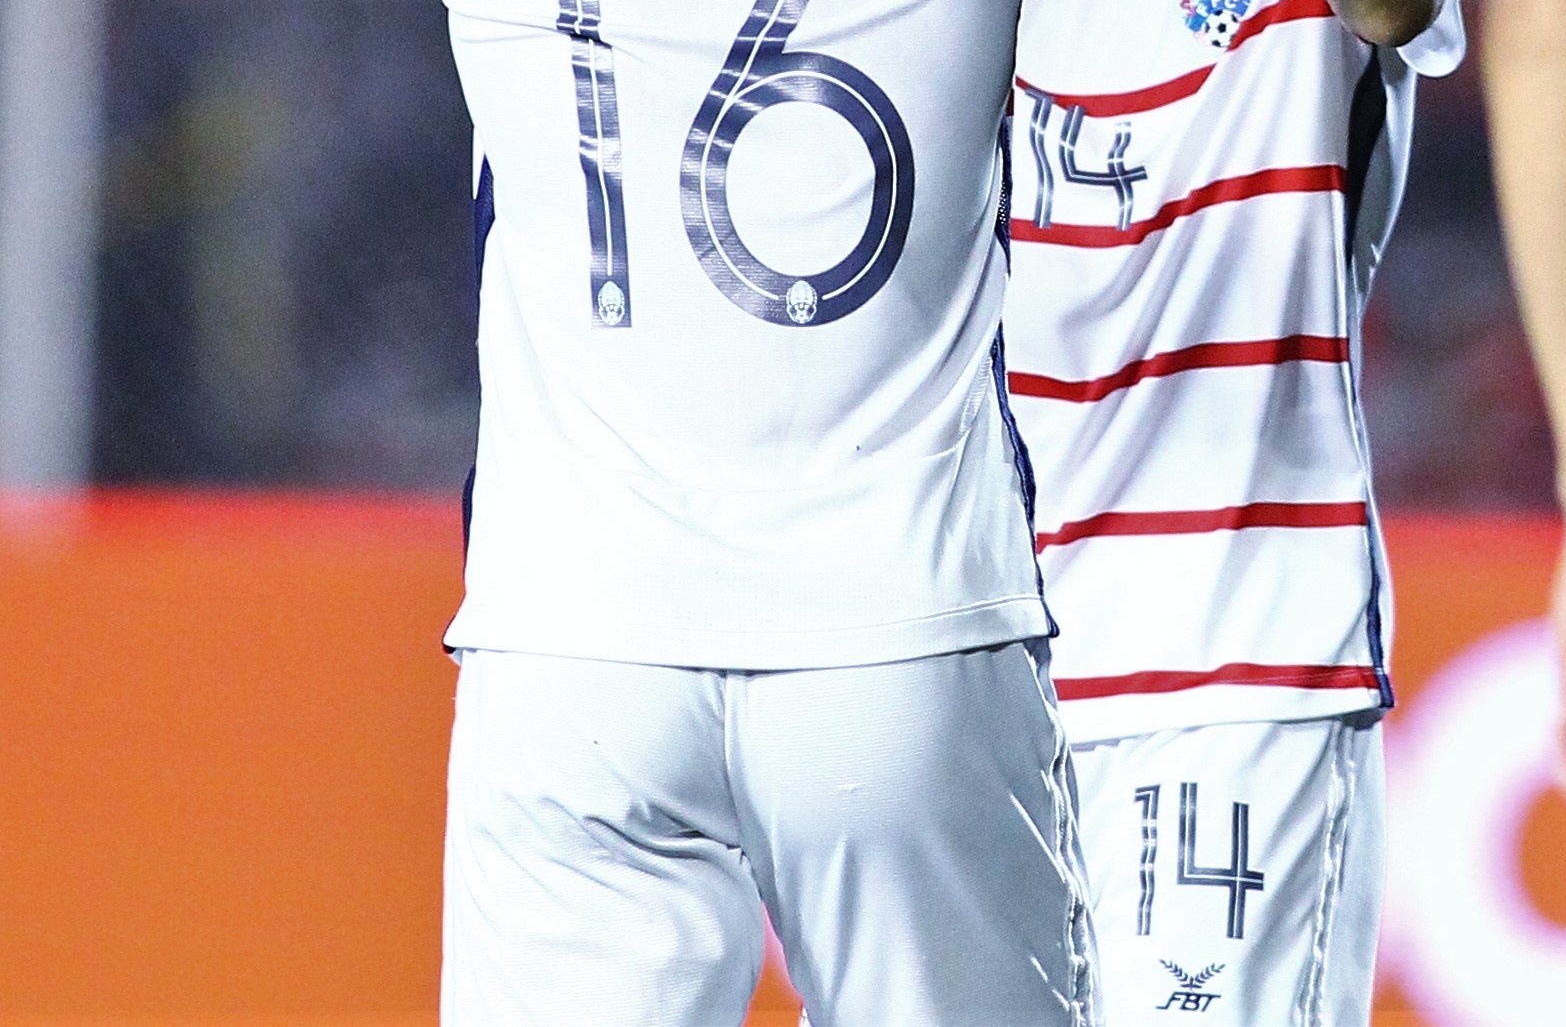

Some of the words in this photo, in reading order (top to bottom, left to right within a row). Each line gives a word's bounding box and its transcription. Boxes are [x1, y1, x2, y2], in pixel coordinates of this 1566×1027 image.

[1025, 88, 1148, 231] 14
[1134, 782, 1264, 939] 14
[1156, 991, 1221, 1012] FBT
